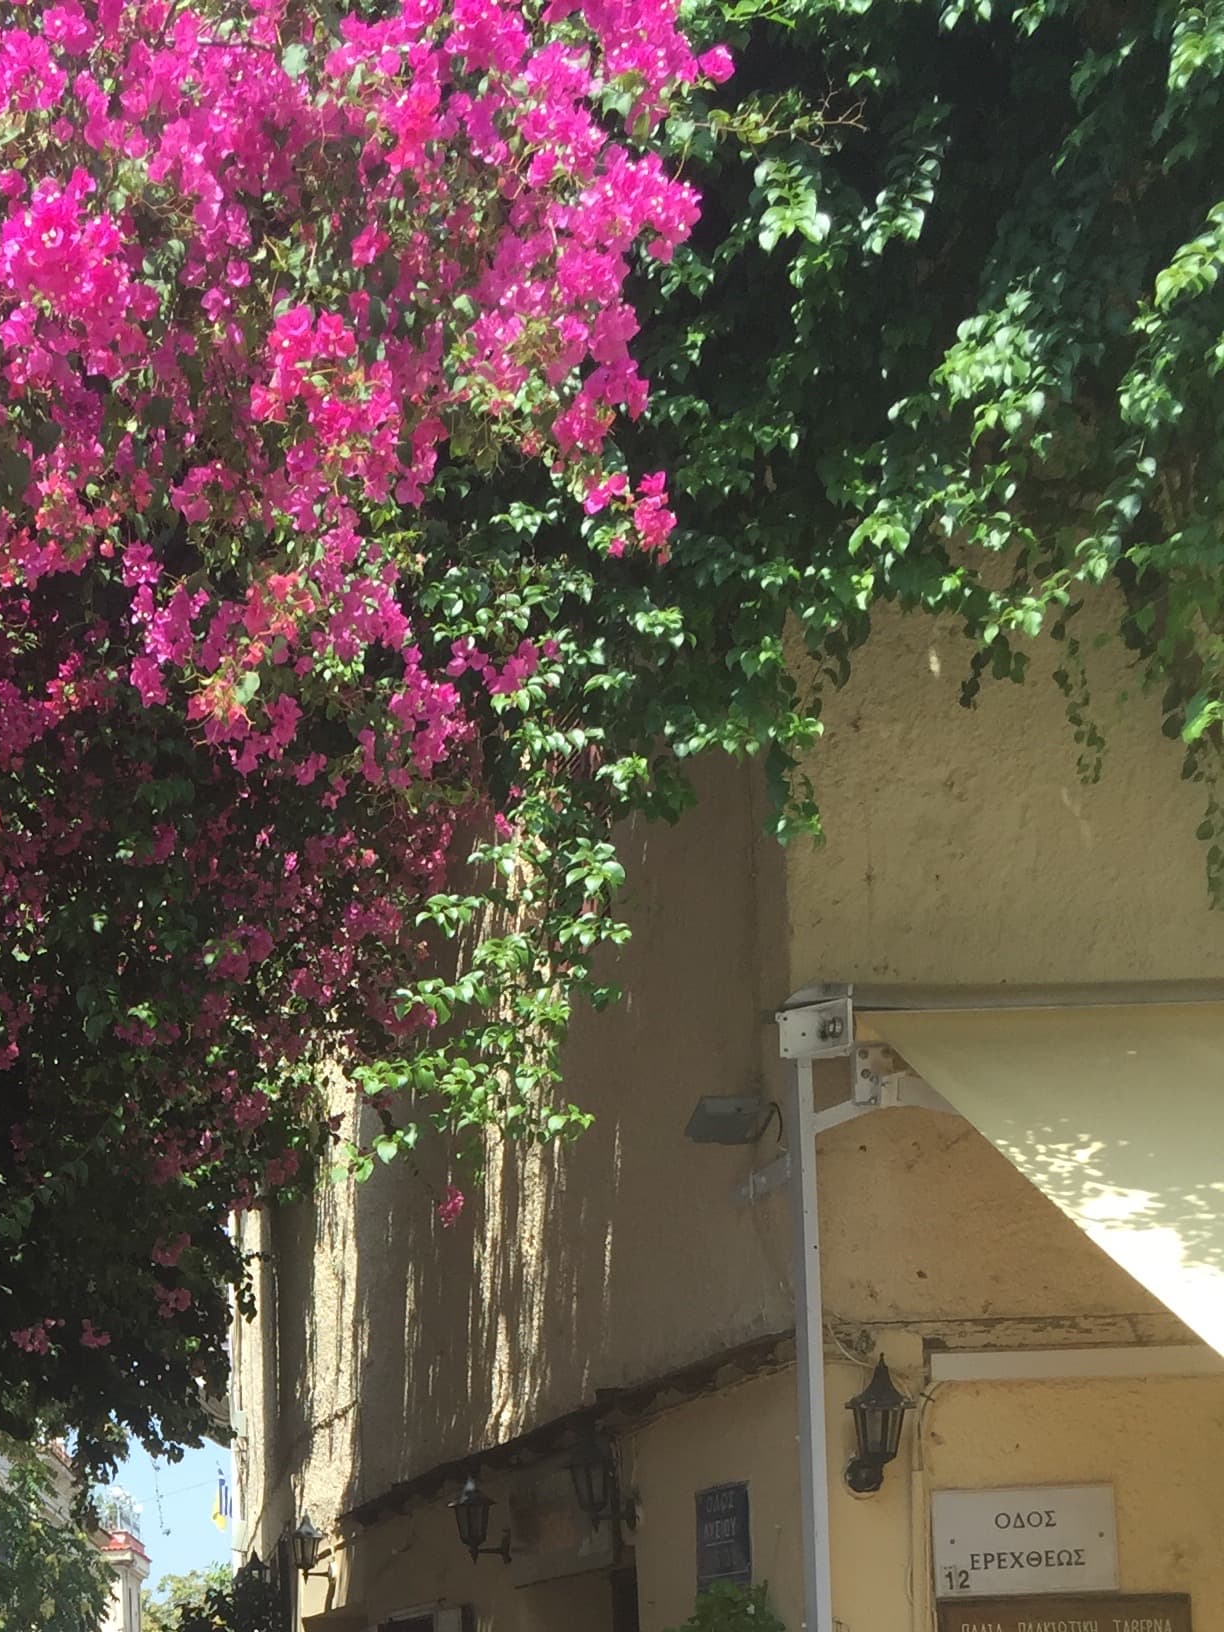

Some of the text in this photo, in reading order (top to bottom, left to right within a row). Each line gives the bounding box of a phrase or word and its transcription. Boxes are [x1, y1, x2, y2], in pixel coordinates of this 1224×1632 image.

[994, 1510, 1057, 1529] ΟΔΟΣ
[970, 1549, 1086, 1570] ΕΡΕΧΘΕΩΣ
[944, 1570, 970, 1590] 12
